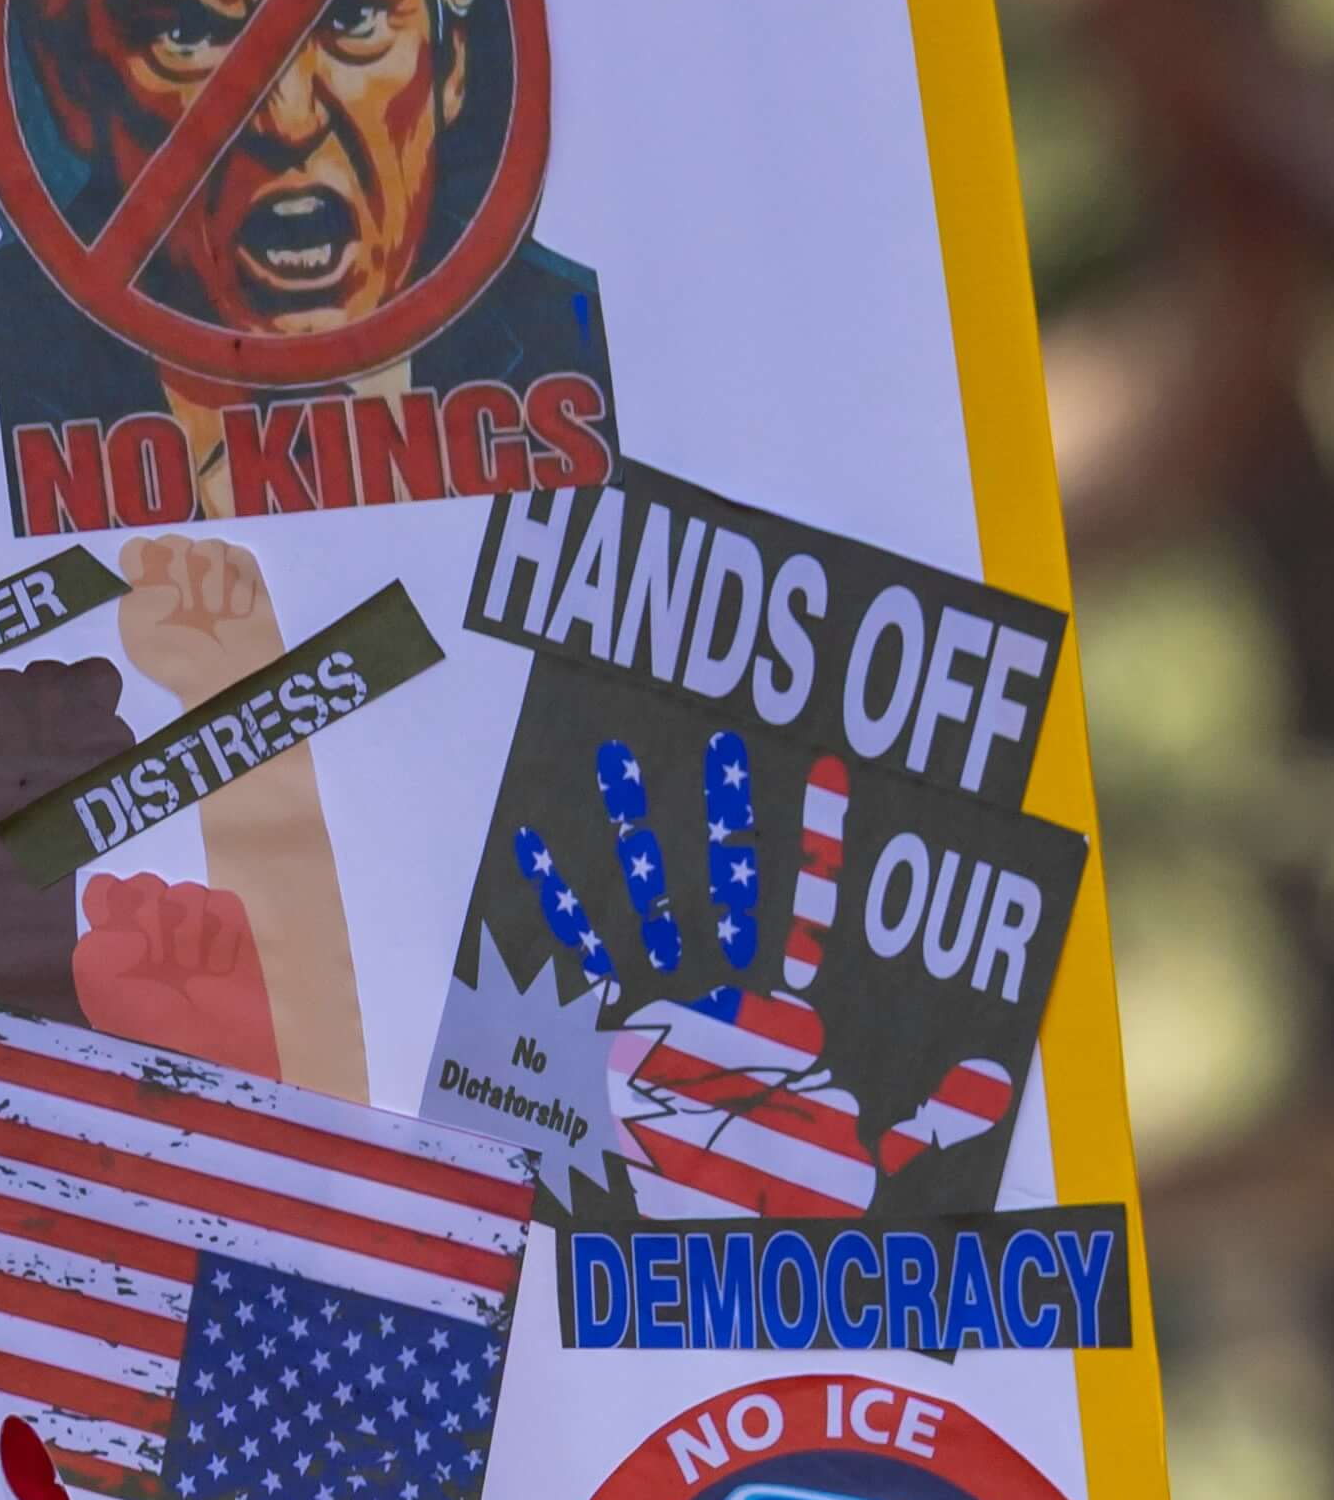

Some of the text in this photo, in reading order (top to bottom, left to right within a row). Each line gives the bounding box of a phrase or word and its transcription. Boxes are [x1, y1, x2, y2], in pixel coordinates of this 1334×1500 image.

[14, 372, 612, 536] NO KINGS
[483, 488, 1047, 792] HANDS OFF
[73, 651, 367, 854] DISTRESS
[865, 833, 1042, 1004] OUR
[438, 1059, 588, 1148] Dictatorship
[511, 1035, 547, 1073] No
[570, 1230, 1114, 1349] DEMOCRACY
[667, 1384, 946, 1484] NO ICE
